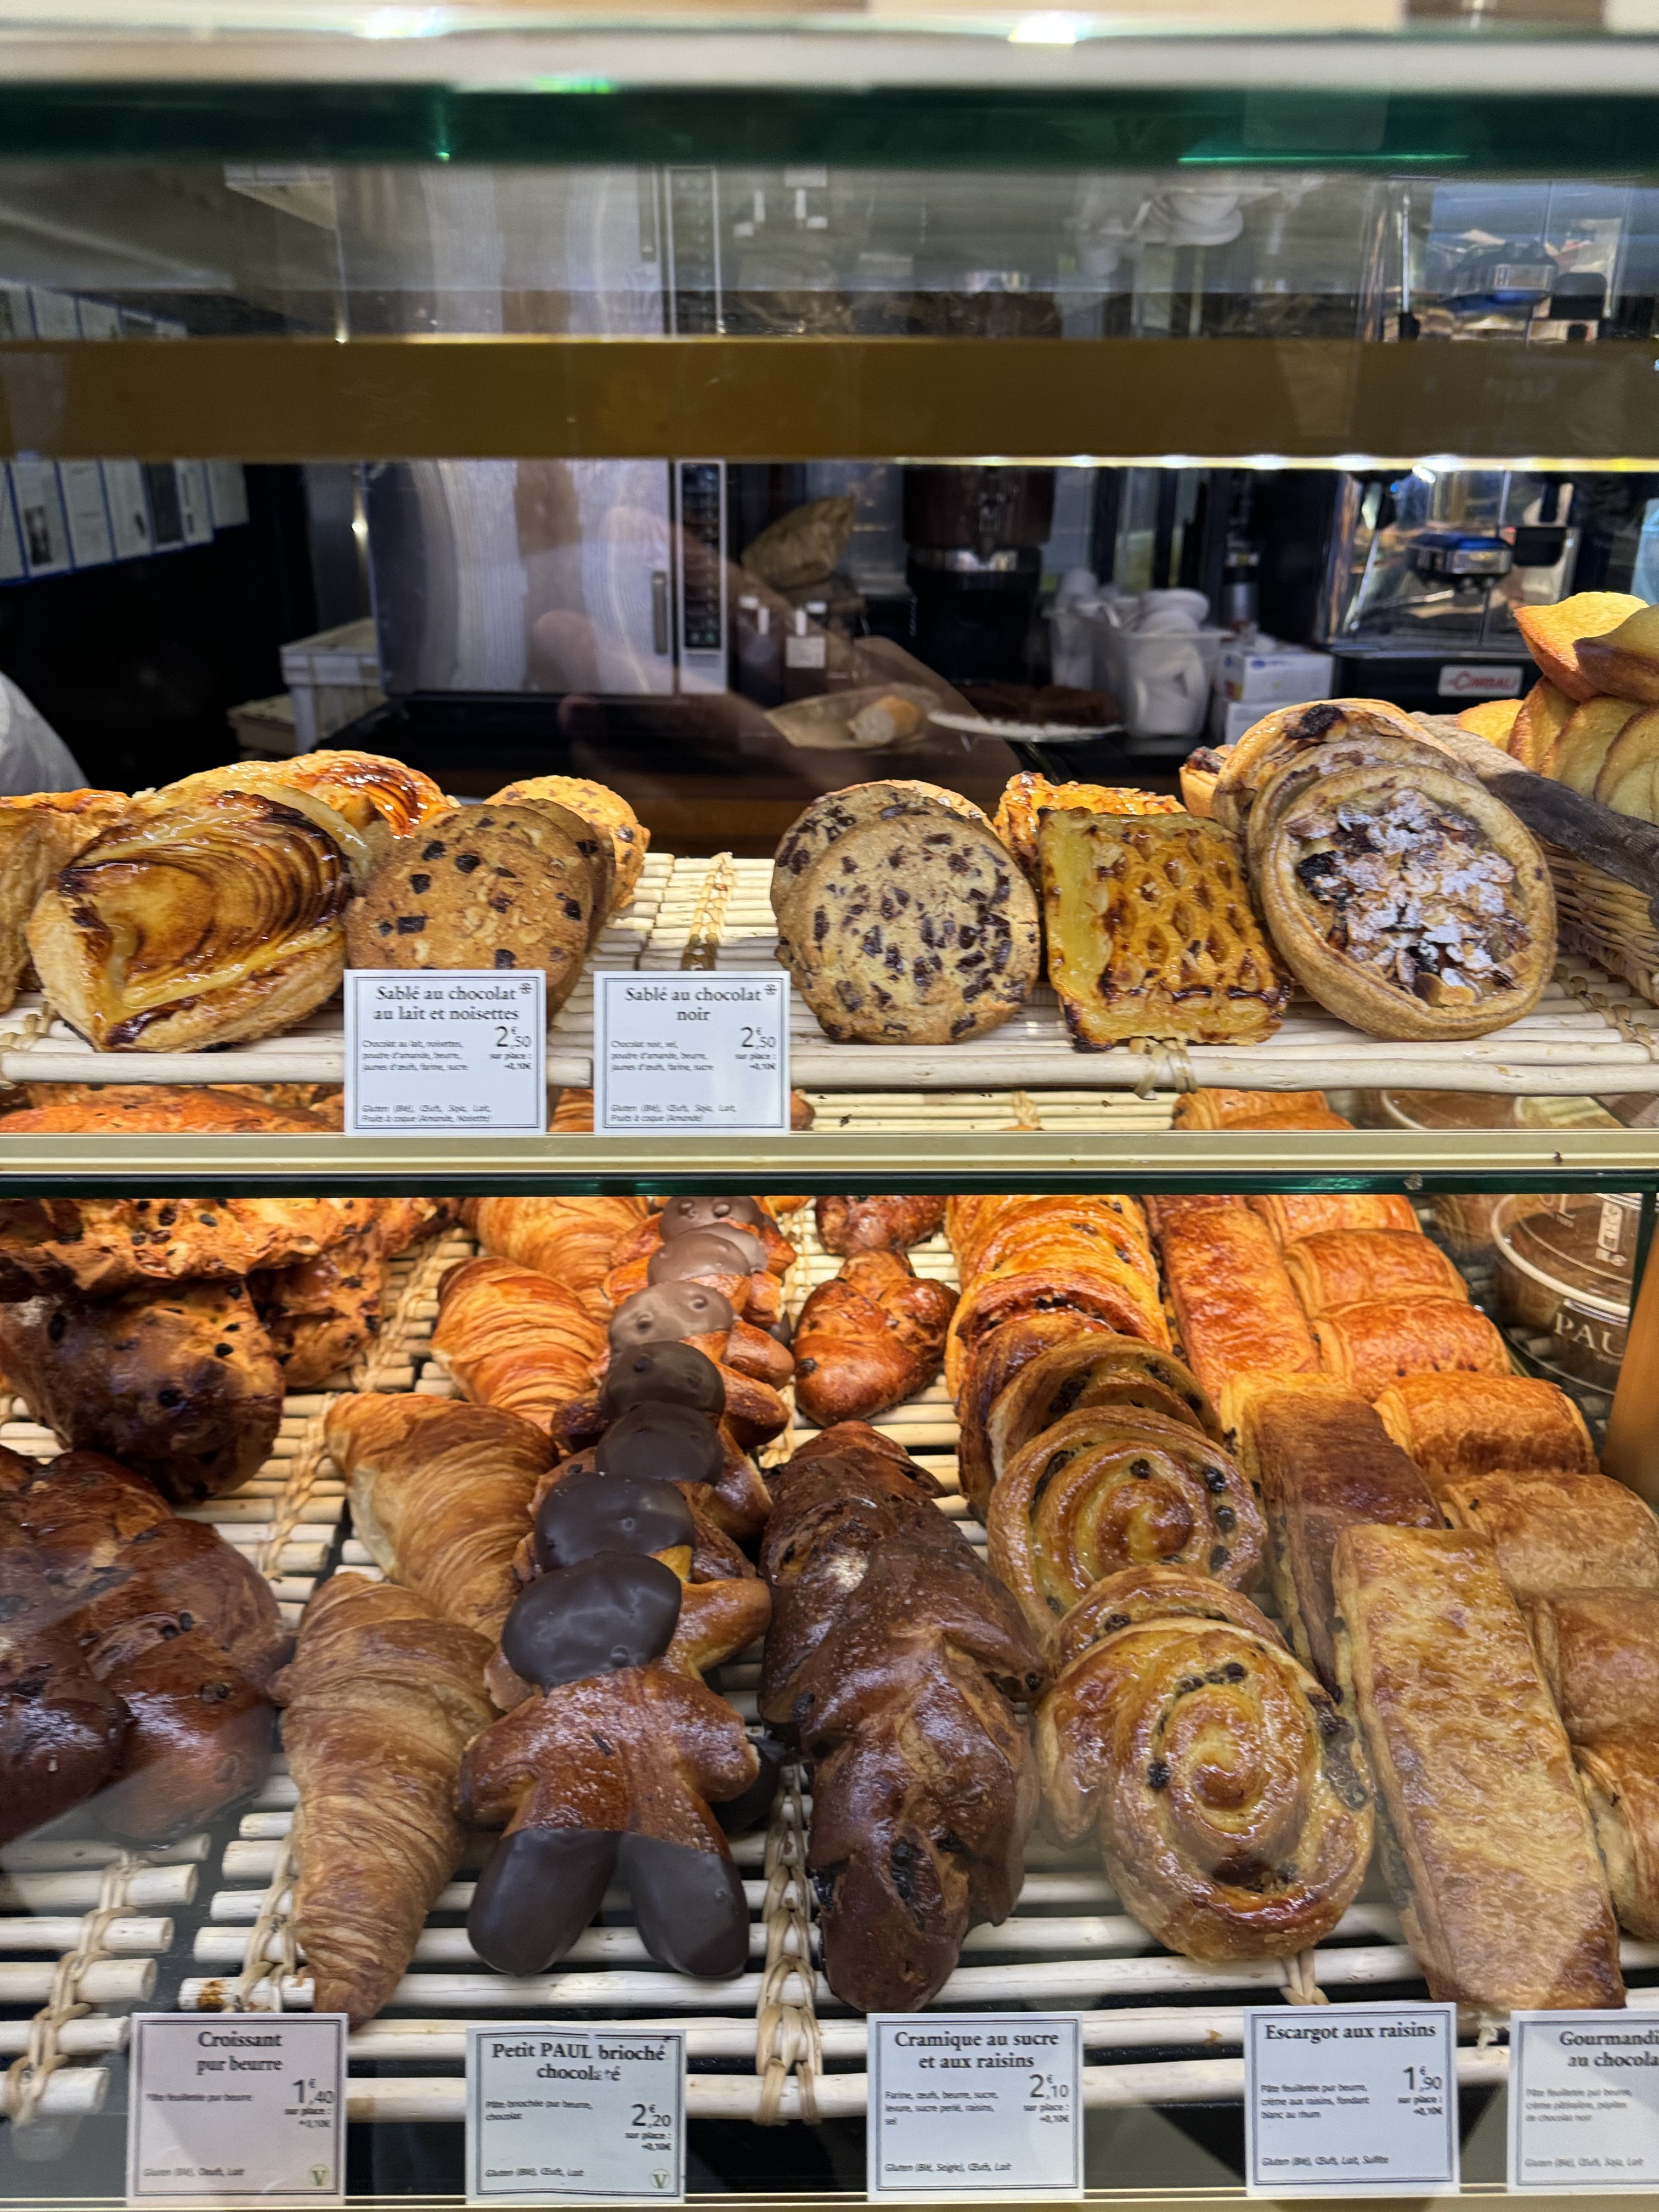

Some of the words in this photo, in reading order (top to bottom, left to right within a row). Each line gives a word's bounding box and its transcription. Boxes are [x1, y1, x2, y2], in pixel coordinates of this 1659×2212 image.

[377, 986, 420, 1000] Sablé
[425, 991, 443, 999] au
[448, 986, 516, 1000] chocolat
[625, 988, 667, 1001] Sablé
[672, 992, 690, 1000] au
[695, 988, 761, 1001] chocolat
[374, 1011, 393, 1019] au
[398, 1006, 426, 1019] lait
[430, 1011, 445, 1019] et
[449, 1006, 519, 1019] noisettes
[676, 1007, 710, 1020] noir
[363, 1040, 397, 1048] Chocolat
[198, 2031, 283, 2047] Croissant
[1265, 2025, 1339, 2044] Escargot
[1343, 2028, 1374, 2038] aux
[1379, 2022, 1436, 2037] raisins
[895, 2031, 982, 2051] Cramique
[986, 2036, 1008, 2046] au
[1013, 2035, 1058, 2045] sucre
[492, 2042, 535, 2058] Petit
[540, 2043, 592, 2058] PAUL
[598, 2045, 666, 2061] brioché
[196, 2061, 227, 2075] pur
[229, 2056, 283, 2070] beurre
[919, 2057, 935, 2068] et
[940, 2058, 972, 2068] aux
[977, 2052, 1034, 2068] raisins
[1568, 2057, 1589, 2067] au
[1594, 2051, 1659, 2067] chocola
[1414, 2096, 1437, 2105] place
[1040, 2104, 1064, 2112] place
[642, 2132, 665, 2140] place
